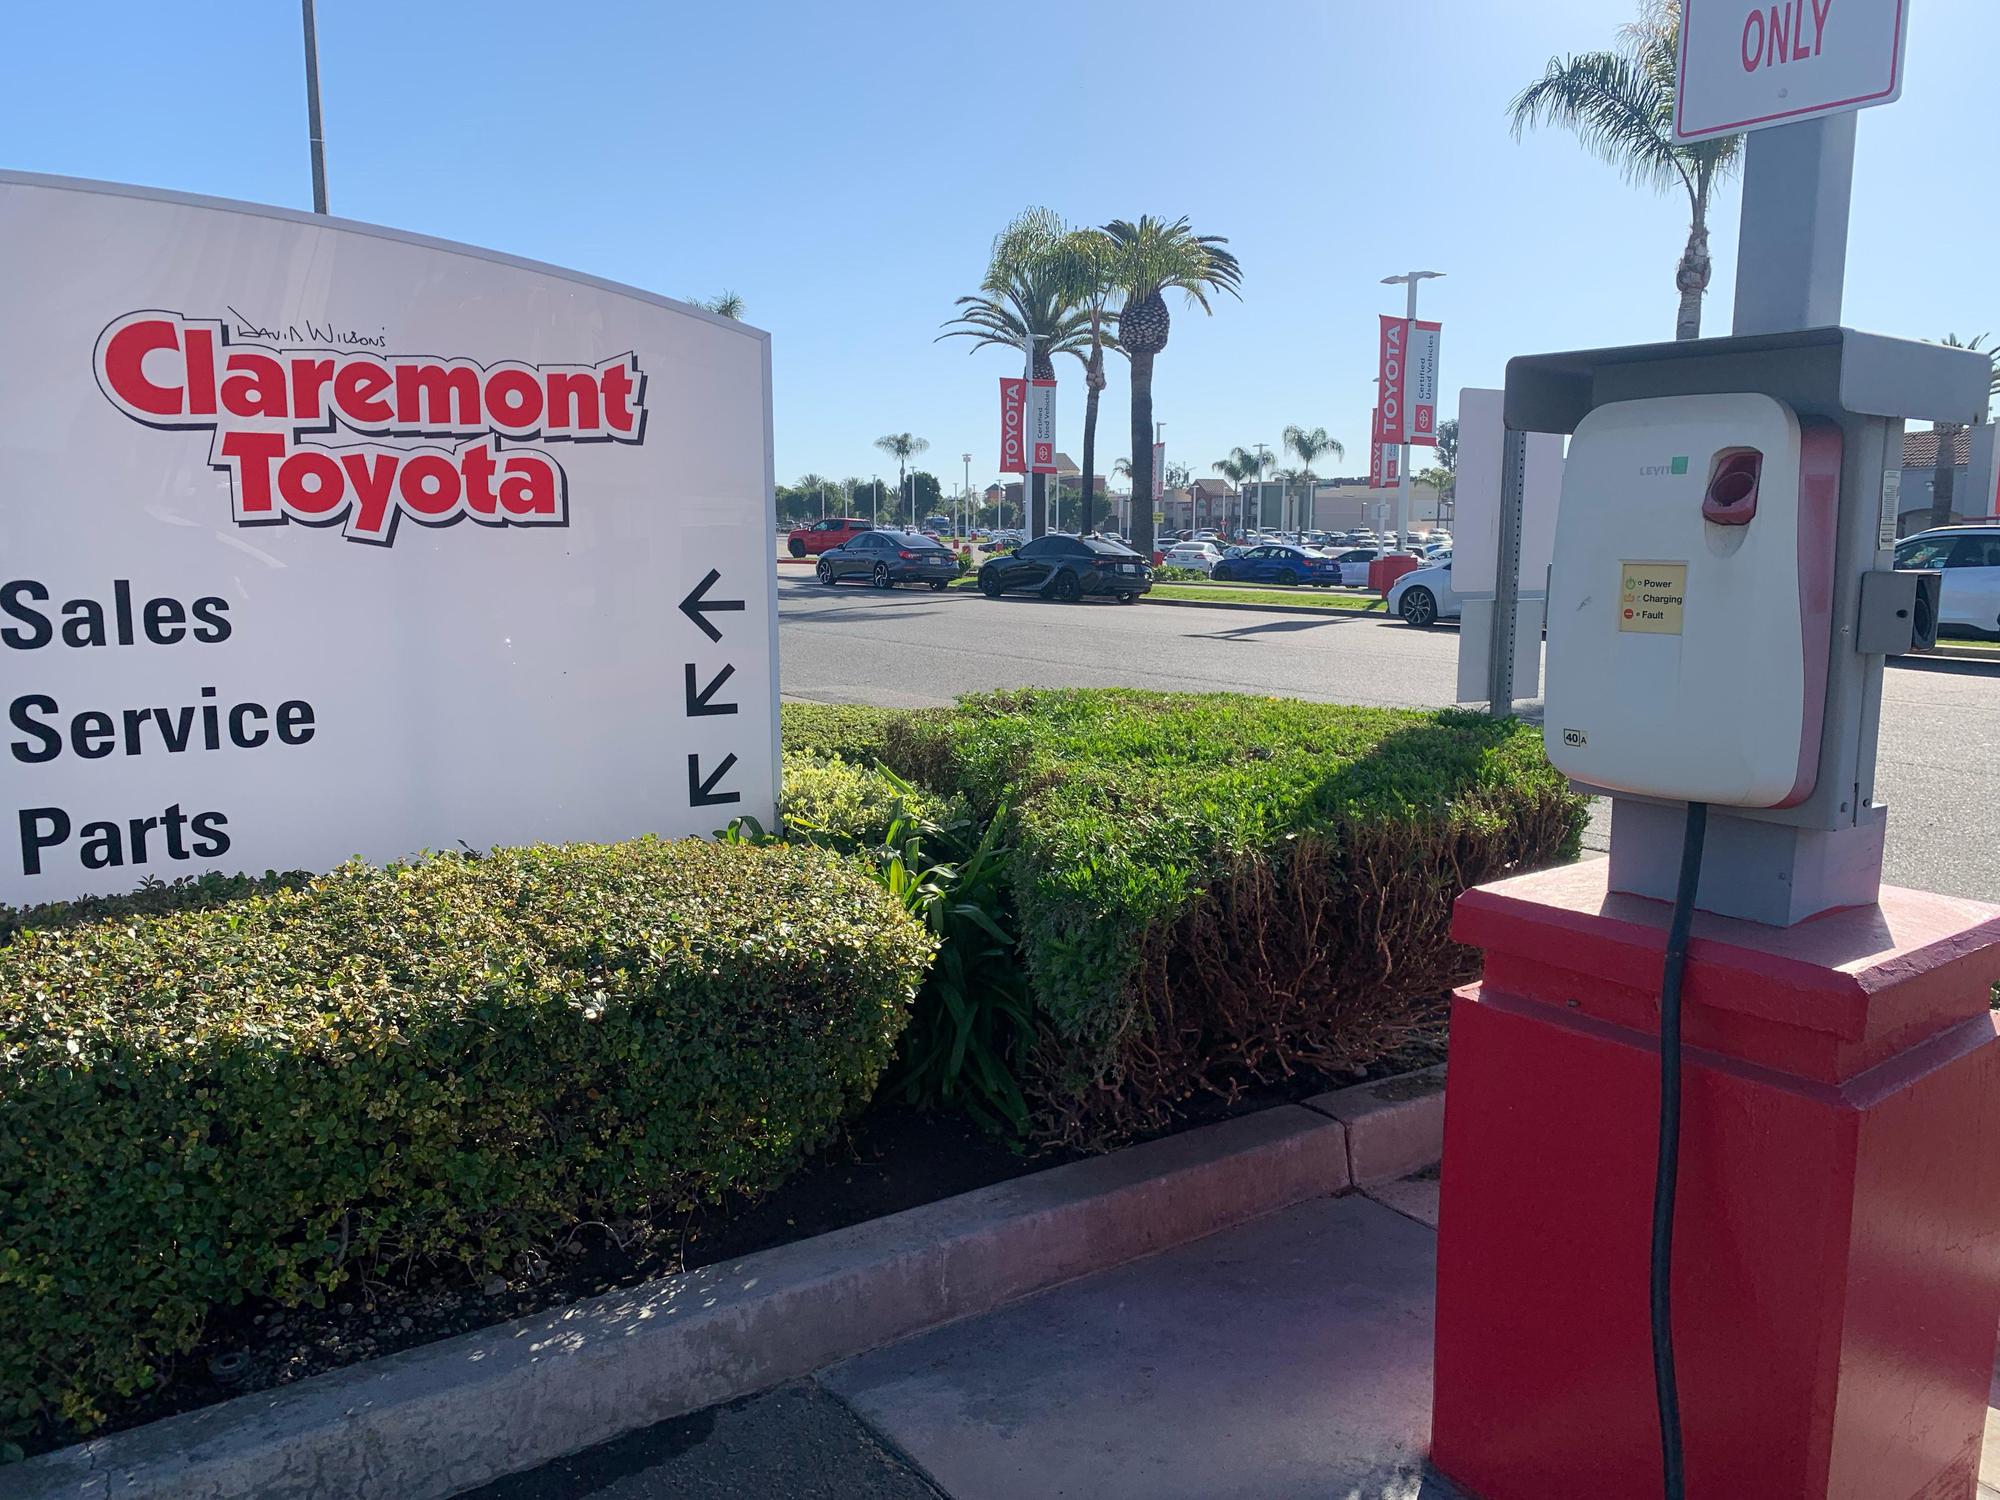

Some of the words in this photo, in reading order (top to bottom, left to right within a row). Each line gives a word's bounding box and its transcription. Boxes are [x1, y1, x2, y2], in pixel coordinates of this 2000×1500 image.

[1742, 0, 1831, 72] ONLY
[104, 320, 636, 432] Claremont
[1383, 325, 1400, 435] TOYOTA
[1006, 384, 1019, 467] TOYOTA
[221, 431, 556, 533] Toyota
[0, 579, 232, 651] Sales
[1641, 610, 1664, 620] Fault
[1642, 594, 1683, 606] Charging
[1643, 579, 1672, 588] Power
[9, 686, 316, 764] Service
[1566, 733, 1578, 743] 40
[18, 803, 231, 876] Parts
